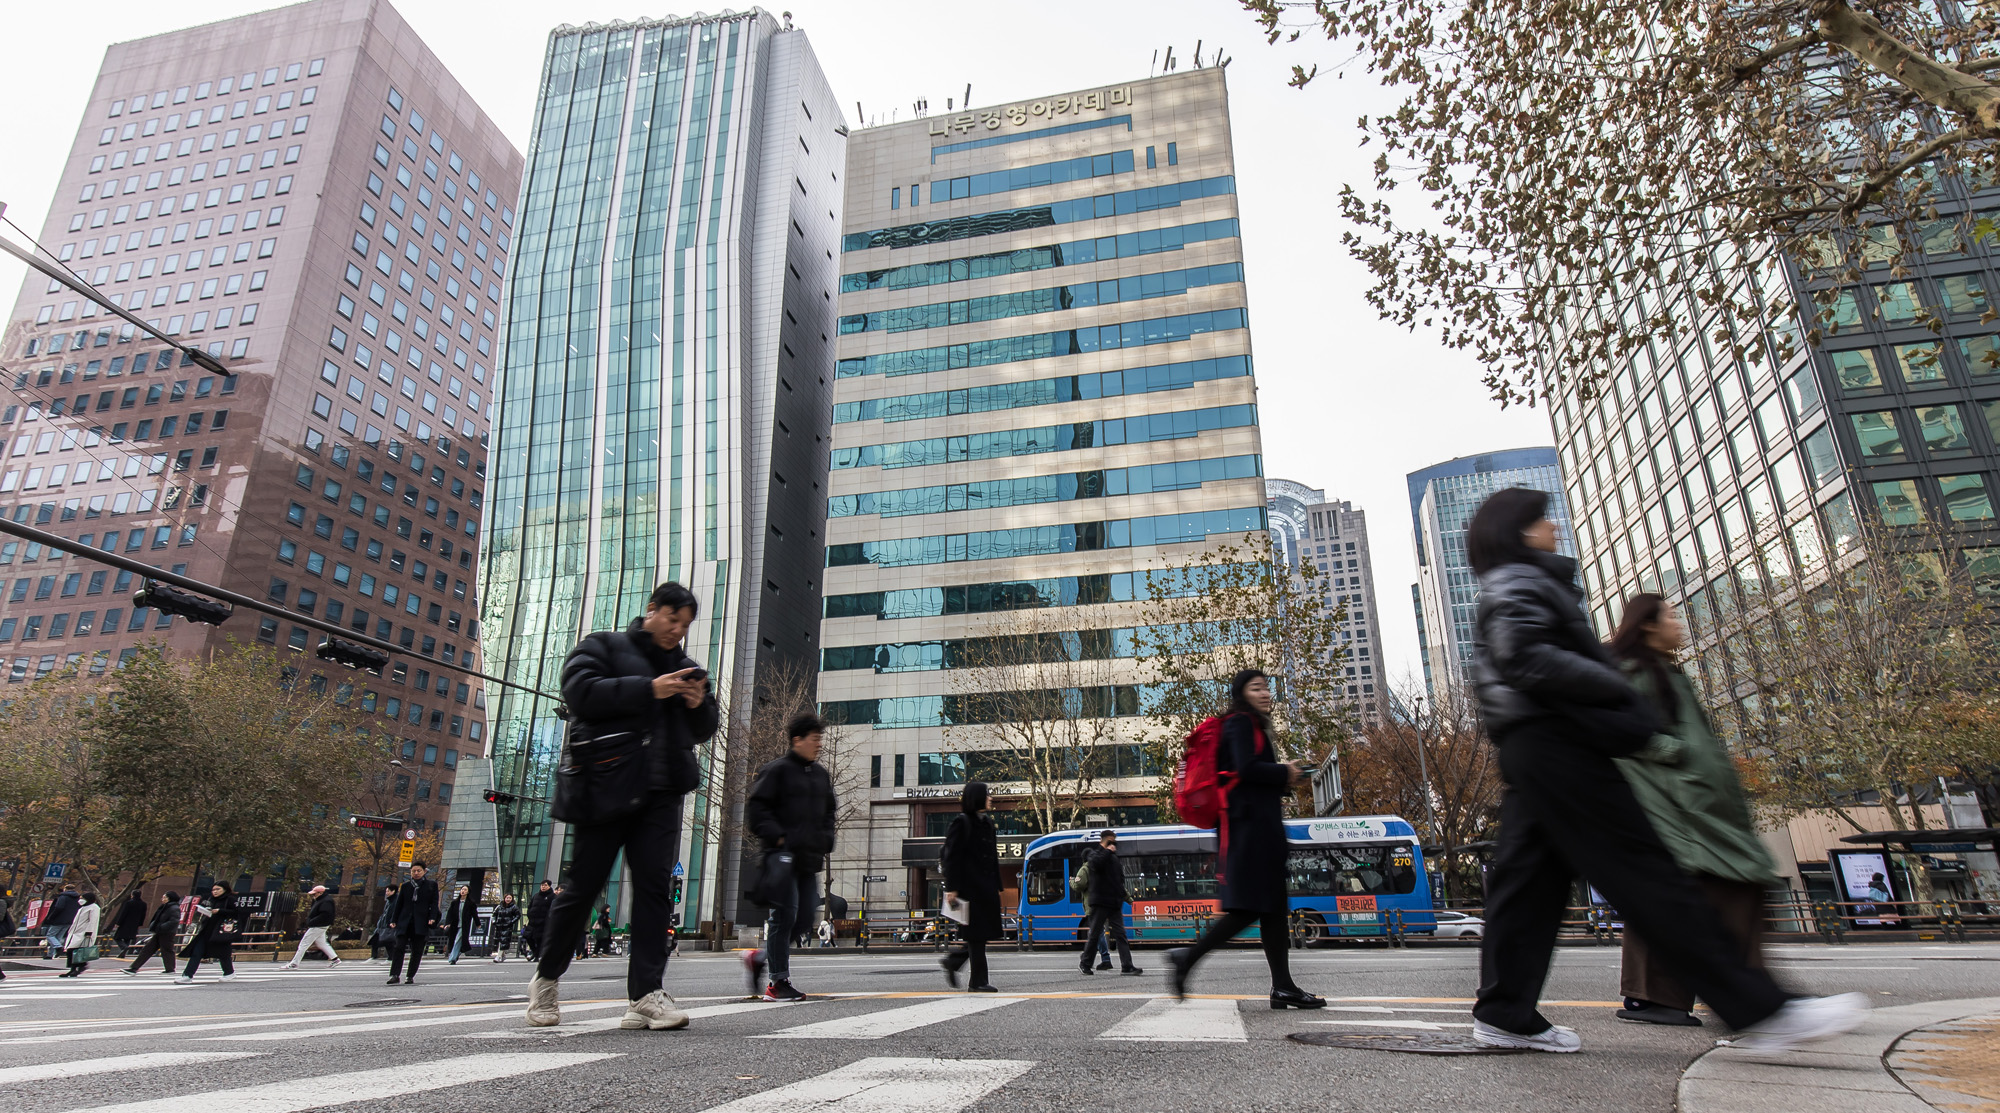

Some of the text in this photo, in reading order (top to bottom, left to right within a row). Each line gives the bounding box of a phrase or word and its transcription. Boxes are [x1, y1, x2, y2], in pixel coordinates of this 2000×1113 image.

[928, 86, 1132, 137] 나무경영아카데미
[1314, 822, 1340, 831] 전기버스
[1337, 829, 1380, 839] 숨 쉬는 서울로
[1393, 858, 1411, 867] 270
